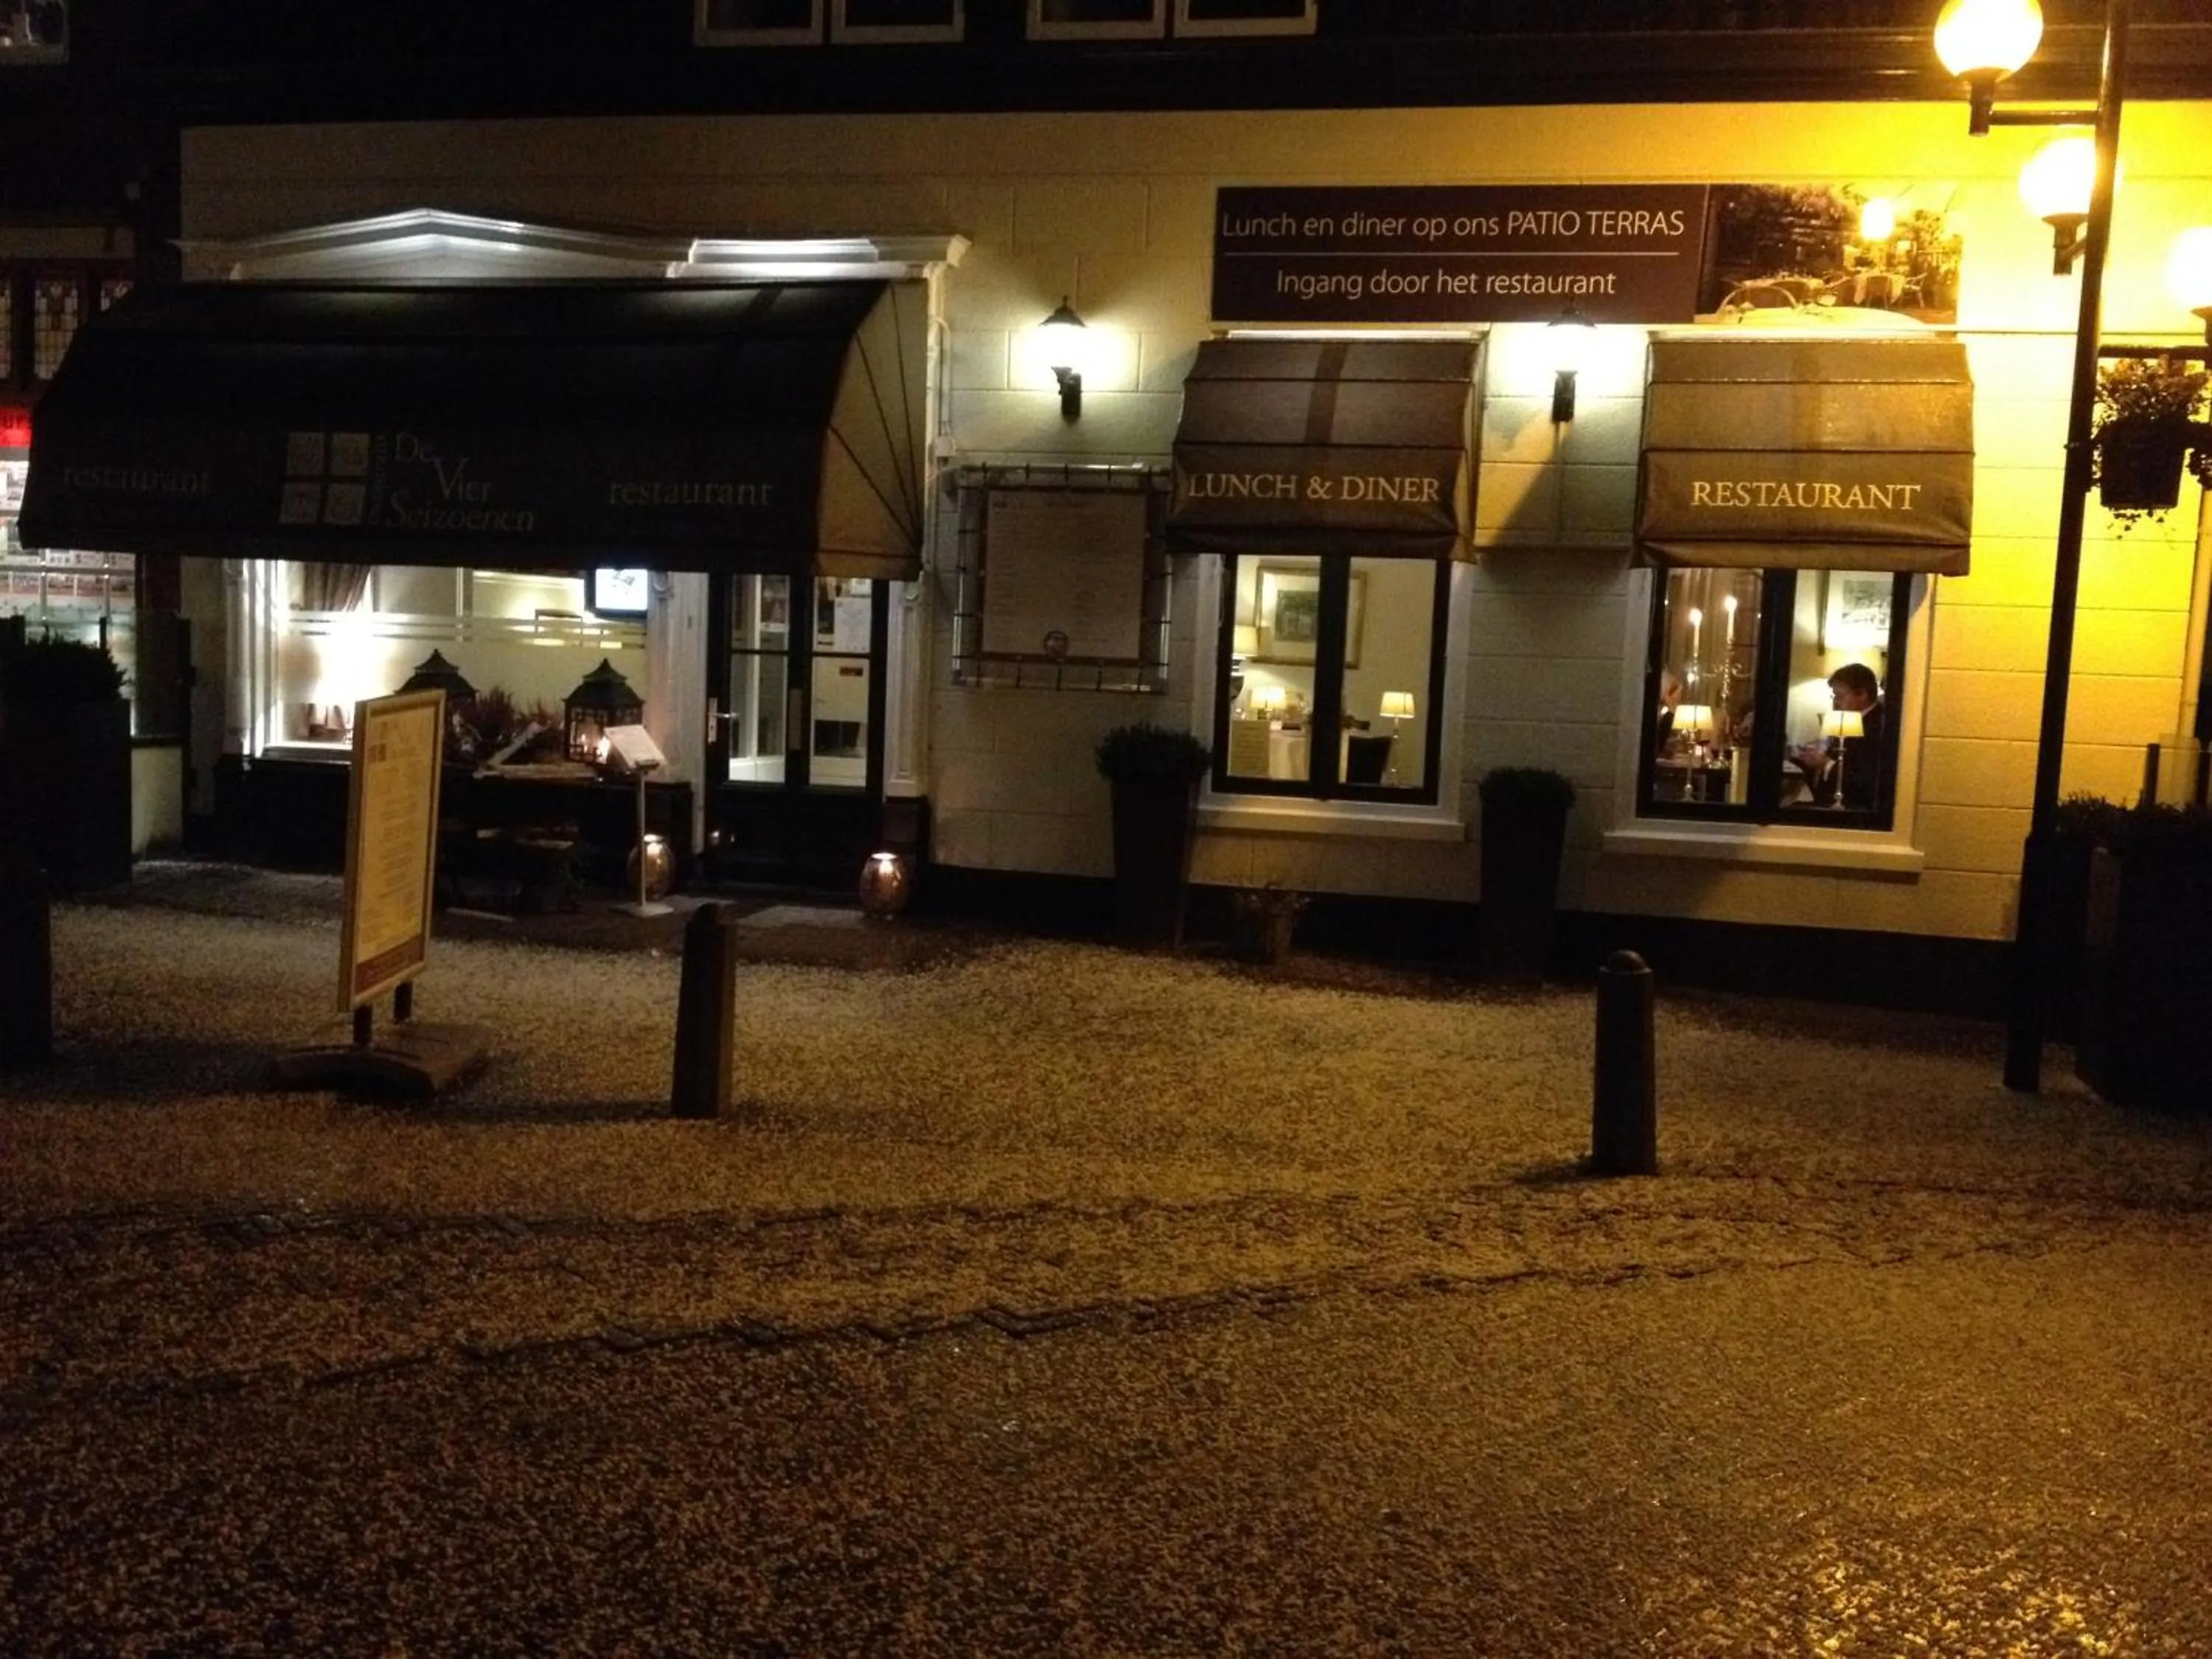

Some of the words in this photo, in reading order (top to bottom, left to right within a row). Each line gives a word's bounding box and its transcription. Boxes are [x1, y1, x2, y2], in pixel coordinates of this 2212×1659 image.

[1222, 211, 1298, 237] Lunch
[1303, 216, 1335, 237] en
[1340, 211, 1407, 237] diner
[1412, 217, 1447, 242] op
[1453, 216, 1500, 236] ons
[1506, 210, 1581, 237] PATIO
[1586, 209, 1686, 237] TERRAS
[1276, 269, 1363, 300] Ingang
[1369, 268, 1430, 295] door
[1436, 268, 1479, 295] het
[1485, 270, 1616, 295] restaurant
[394, 431, 437, 463] De
[433, 455, 493, 503] Vier
[609, 482, 773, 506] restaurant
[1189, 473, 1298, 498] LUNCH
[1306, 476, 1333, 501] &
[1340, 476, 1440, 503] DINER
[385, 489, 535, 532] Seizoenen
[1690, 481, 1923, 511] RESTAURANT
